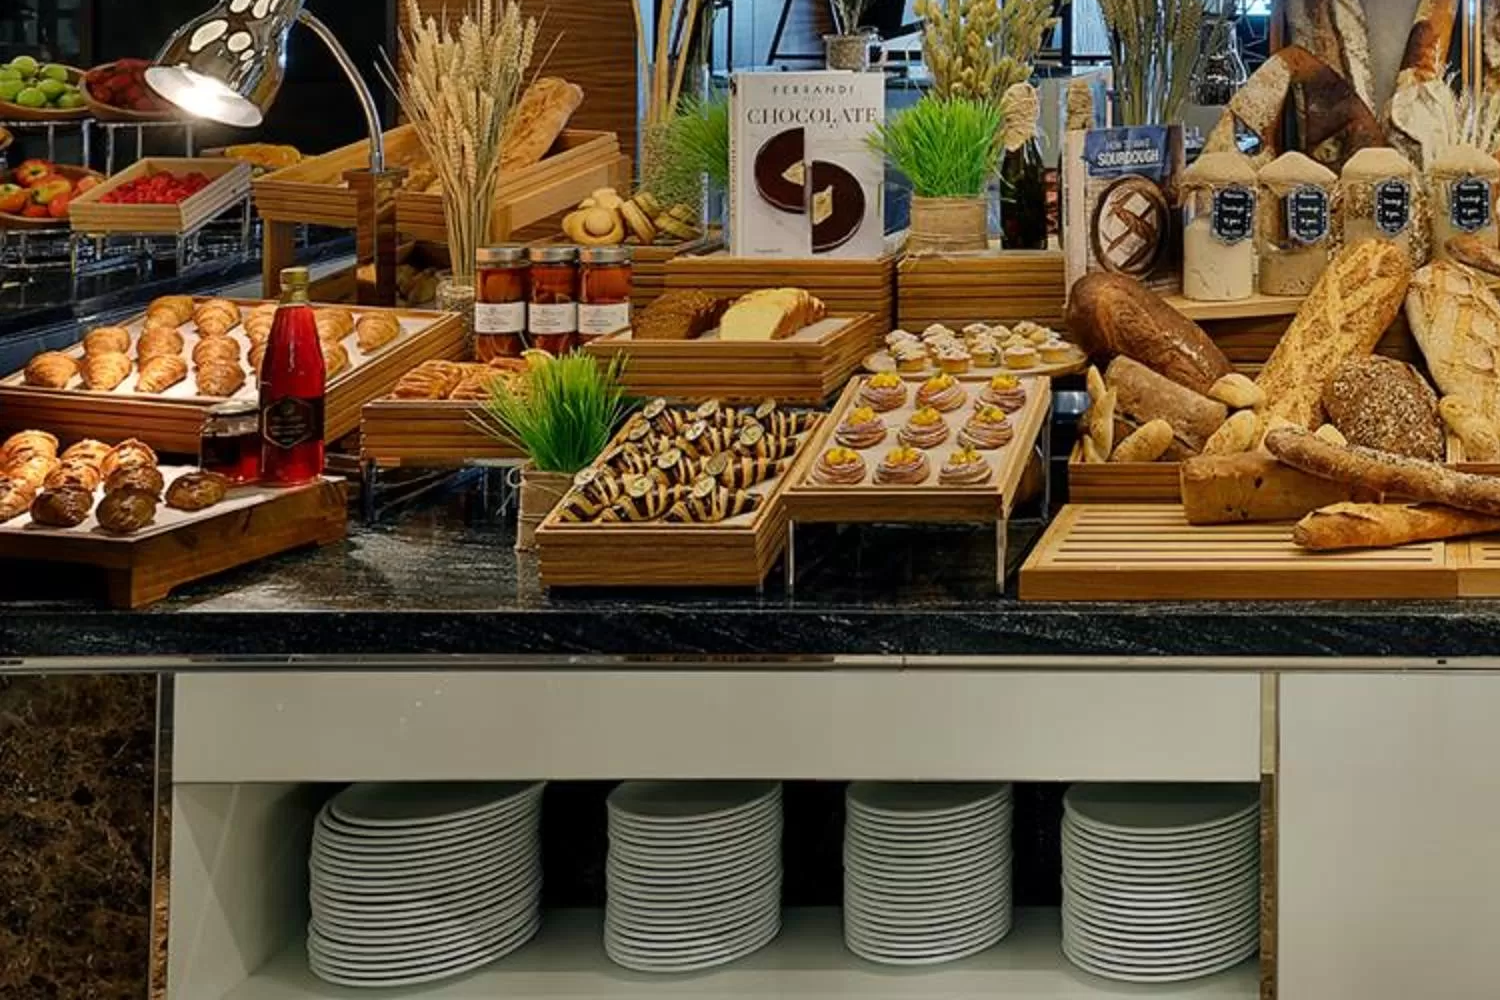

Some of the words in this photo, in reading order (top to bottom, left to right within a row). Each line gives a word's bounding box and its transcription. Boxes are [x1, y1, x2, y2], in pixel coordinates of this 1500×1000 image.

[773, 85, 854, 95] FERRANDI
[747, 107, 877, 125] CHOCOLATE
[1097, 148, 1159, 167] SOURDOUGH
